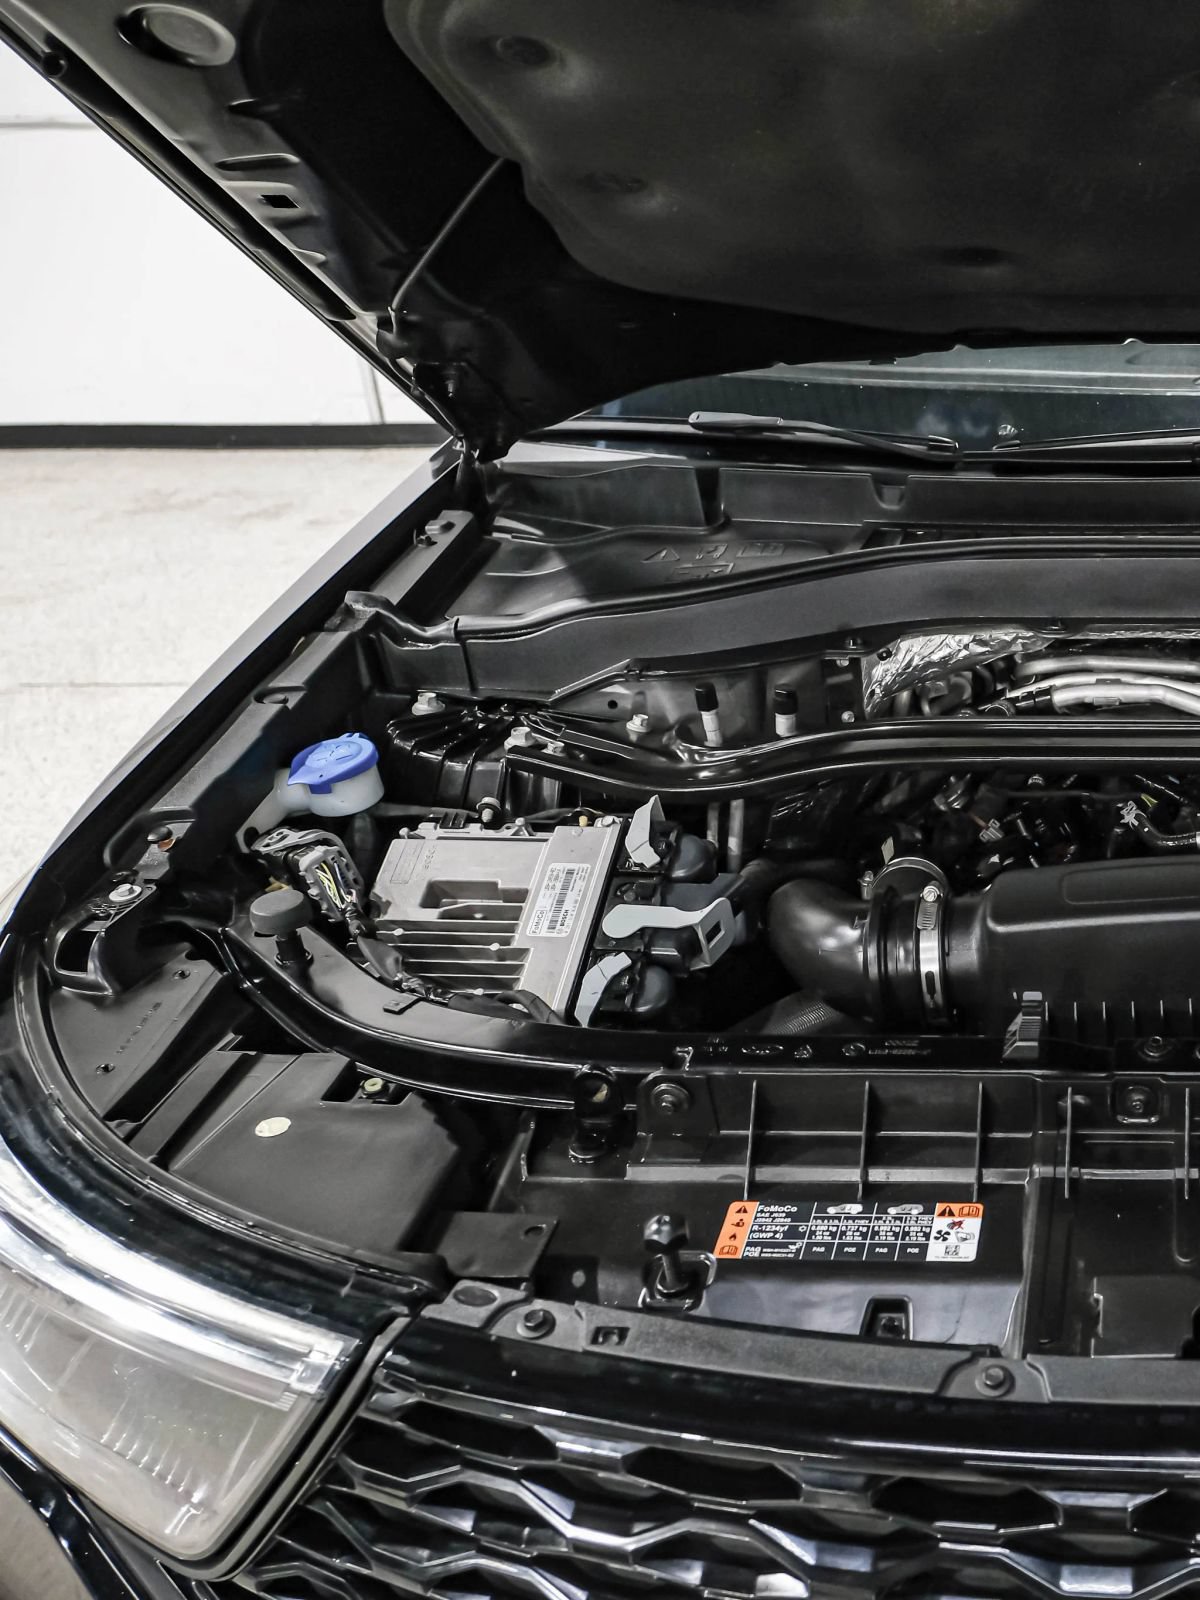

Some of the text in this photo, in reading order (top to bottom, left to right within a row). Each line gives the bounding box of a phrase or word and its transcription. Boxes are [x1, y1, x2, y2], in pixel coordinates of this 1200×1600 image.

[531, 910, 545, 934] FoMoCo
[560, 909, 570, 926] BOSCH
[757, 1204, 798, 1212] FoMoCo
